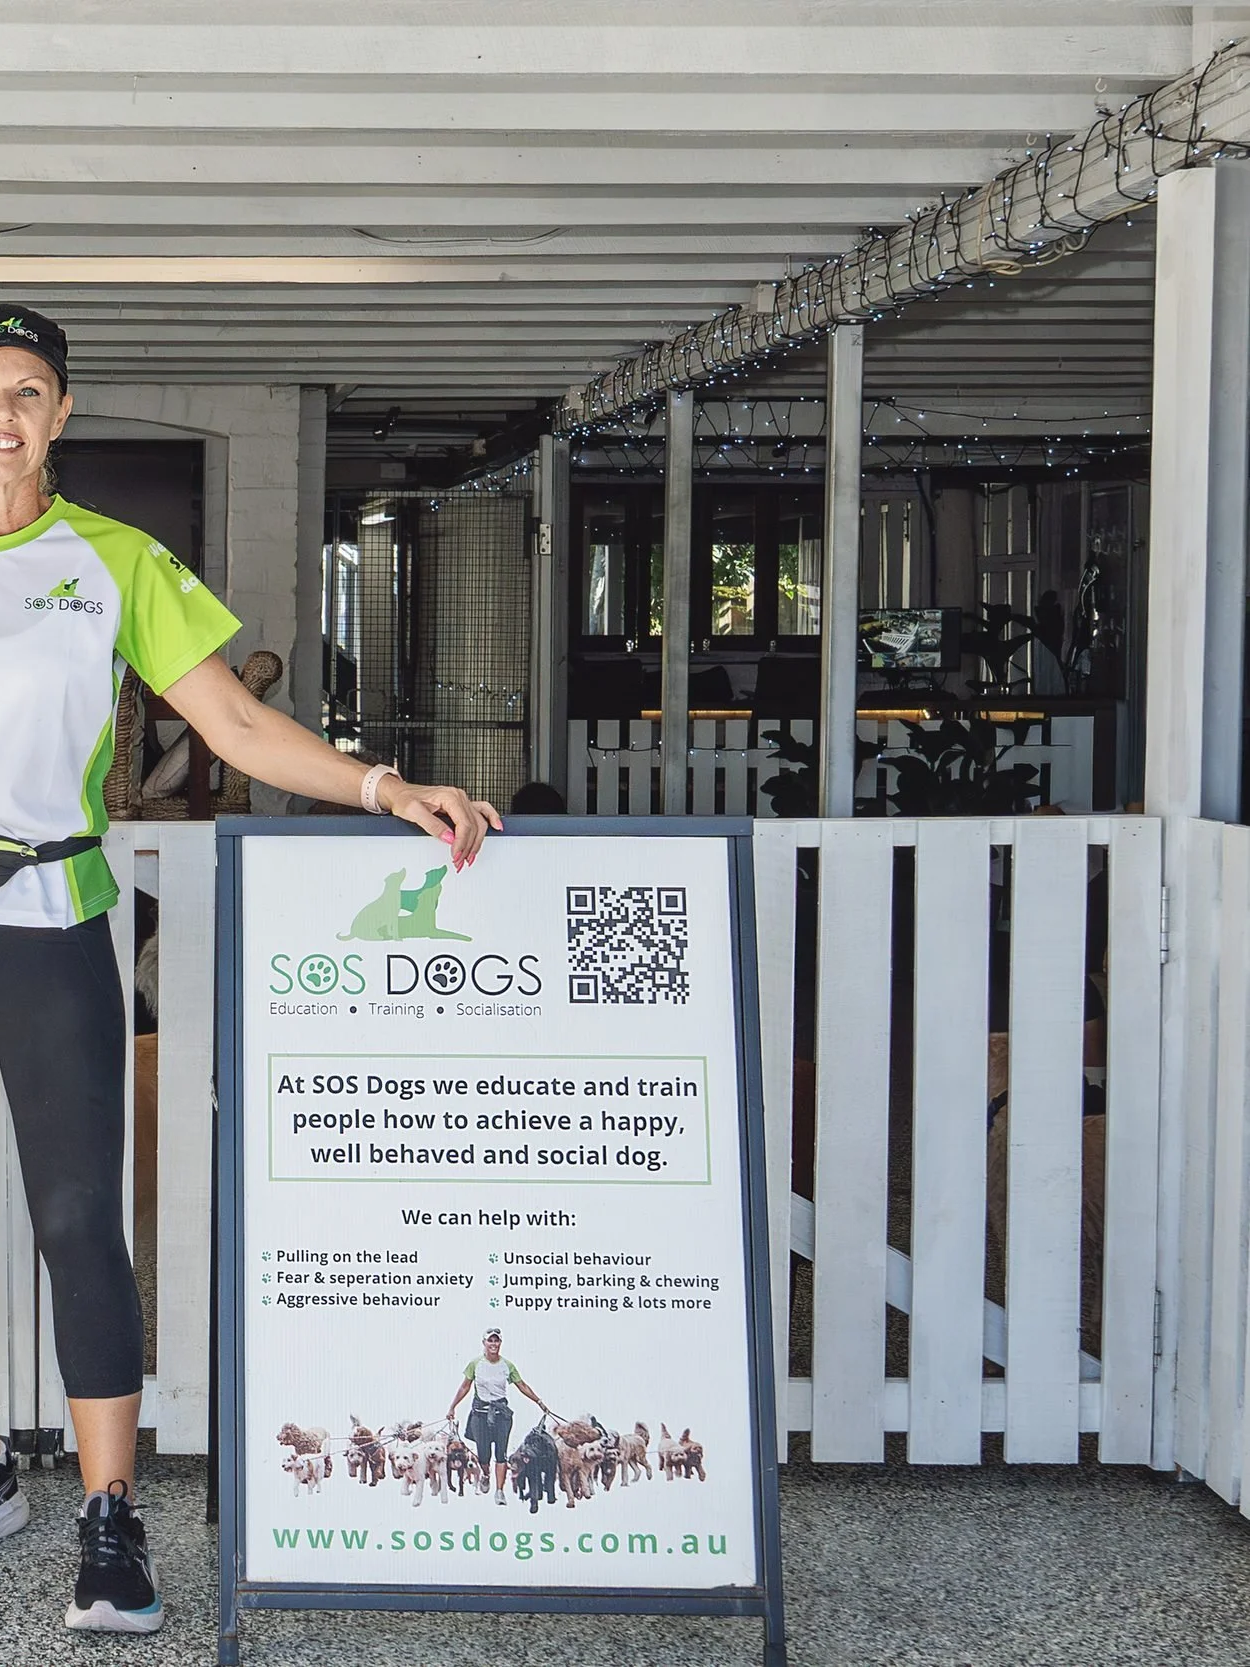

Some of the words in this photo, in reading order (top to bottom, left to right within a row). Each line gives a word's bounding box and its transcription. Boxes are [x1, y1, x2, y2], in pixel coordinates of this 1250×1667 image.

[7, 326, 39, 343] DOGS
[24, 597, 54, 610] SOS
[58, 598, 104, 615] DOGS
[269, 953, 366, 996] SOS
[386, 953, 542, 997] DOGS
[269, 1001, 338, 1016] Education
[368, 1002, 425, 1019] Training
[456, 1002, 542, 1017] Socialisation
[277, 1074, 306, 1095] At
[312, 1074, 359, 1095] SOS
[366, 1075, 426, 1101] Dogs
[432, 1079, 469, 1096] we
[475, 1074, 576, 1096] educate
[583, 1075, 630, 1097] and
[636, 1076, 698, 1097] train
[293, 1108, 376, 1135] people
[383, 1108, 436, 1130] how
[442, 1111, 469, 1130] to
[476, 1109, 572, 1131] achieve
[578, 1115, 593, 1131] a
[601, 1110, 685, 1138] happy,
[310, 1142, 361, 1164] well
[369, 1142, 475, 1165] behaved
[482, 1144, 529, 1165] and
[537, 1144, 608, 1166] social
[615, 1145, 668, 1172] dog.
[401, 1209, 433, 1225] We
[437, 1212, 472, 1226] can
[478, 1208, 521, 1231] help
[525, 1209, 576, 1227] with:
[276, 1249, 329, 1267] Pulling
[332, 1252, 352, 1263] on
[355, 1249, 382, 1264] the
[386, 1249, 418, 1264] lead
[503, 1251, 569, 1266] Unsocial
[573, 1251, 652, 1266] behaviour
[276, 1271, 310, 1284] Fear
[313, 1271, 326, 1284] &
[329, 1271, 412, 1288] seperation
[416, 1271, 474, 1289] anxiety
[502, 1273, 572, 1290] Jumping,
[576, 1273, 636, 1291] barking
[639, 1274, 652, 1288] &
[655, 1274, 720, 1292] chewing
[276, 1292, 358, 1309] Aggressive
[362, 1292, 441, 1307] behaviour
[505, 1294, 553, 1312] Puppy
[556, 1294, 619, 1312] training
[622, 1295, 635, 1309] &
[638, 1295, 667, 1309] lots
[671, 1298, 712, 1310] more
[272, 1524, 727, 1561] www.sosdogs.com.au
